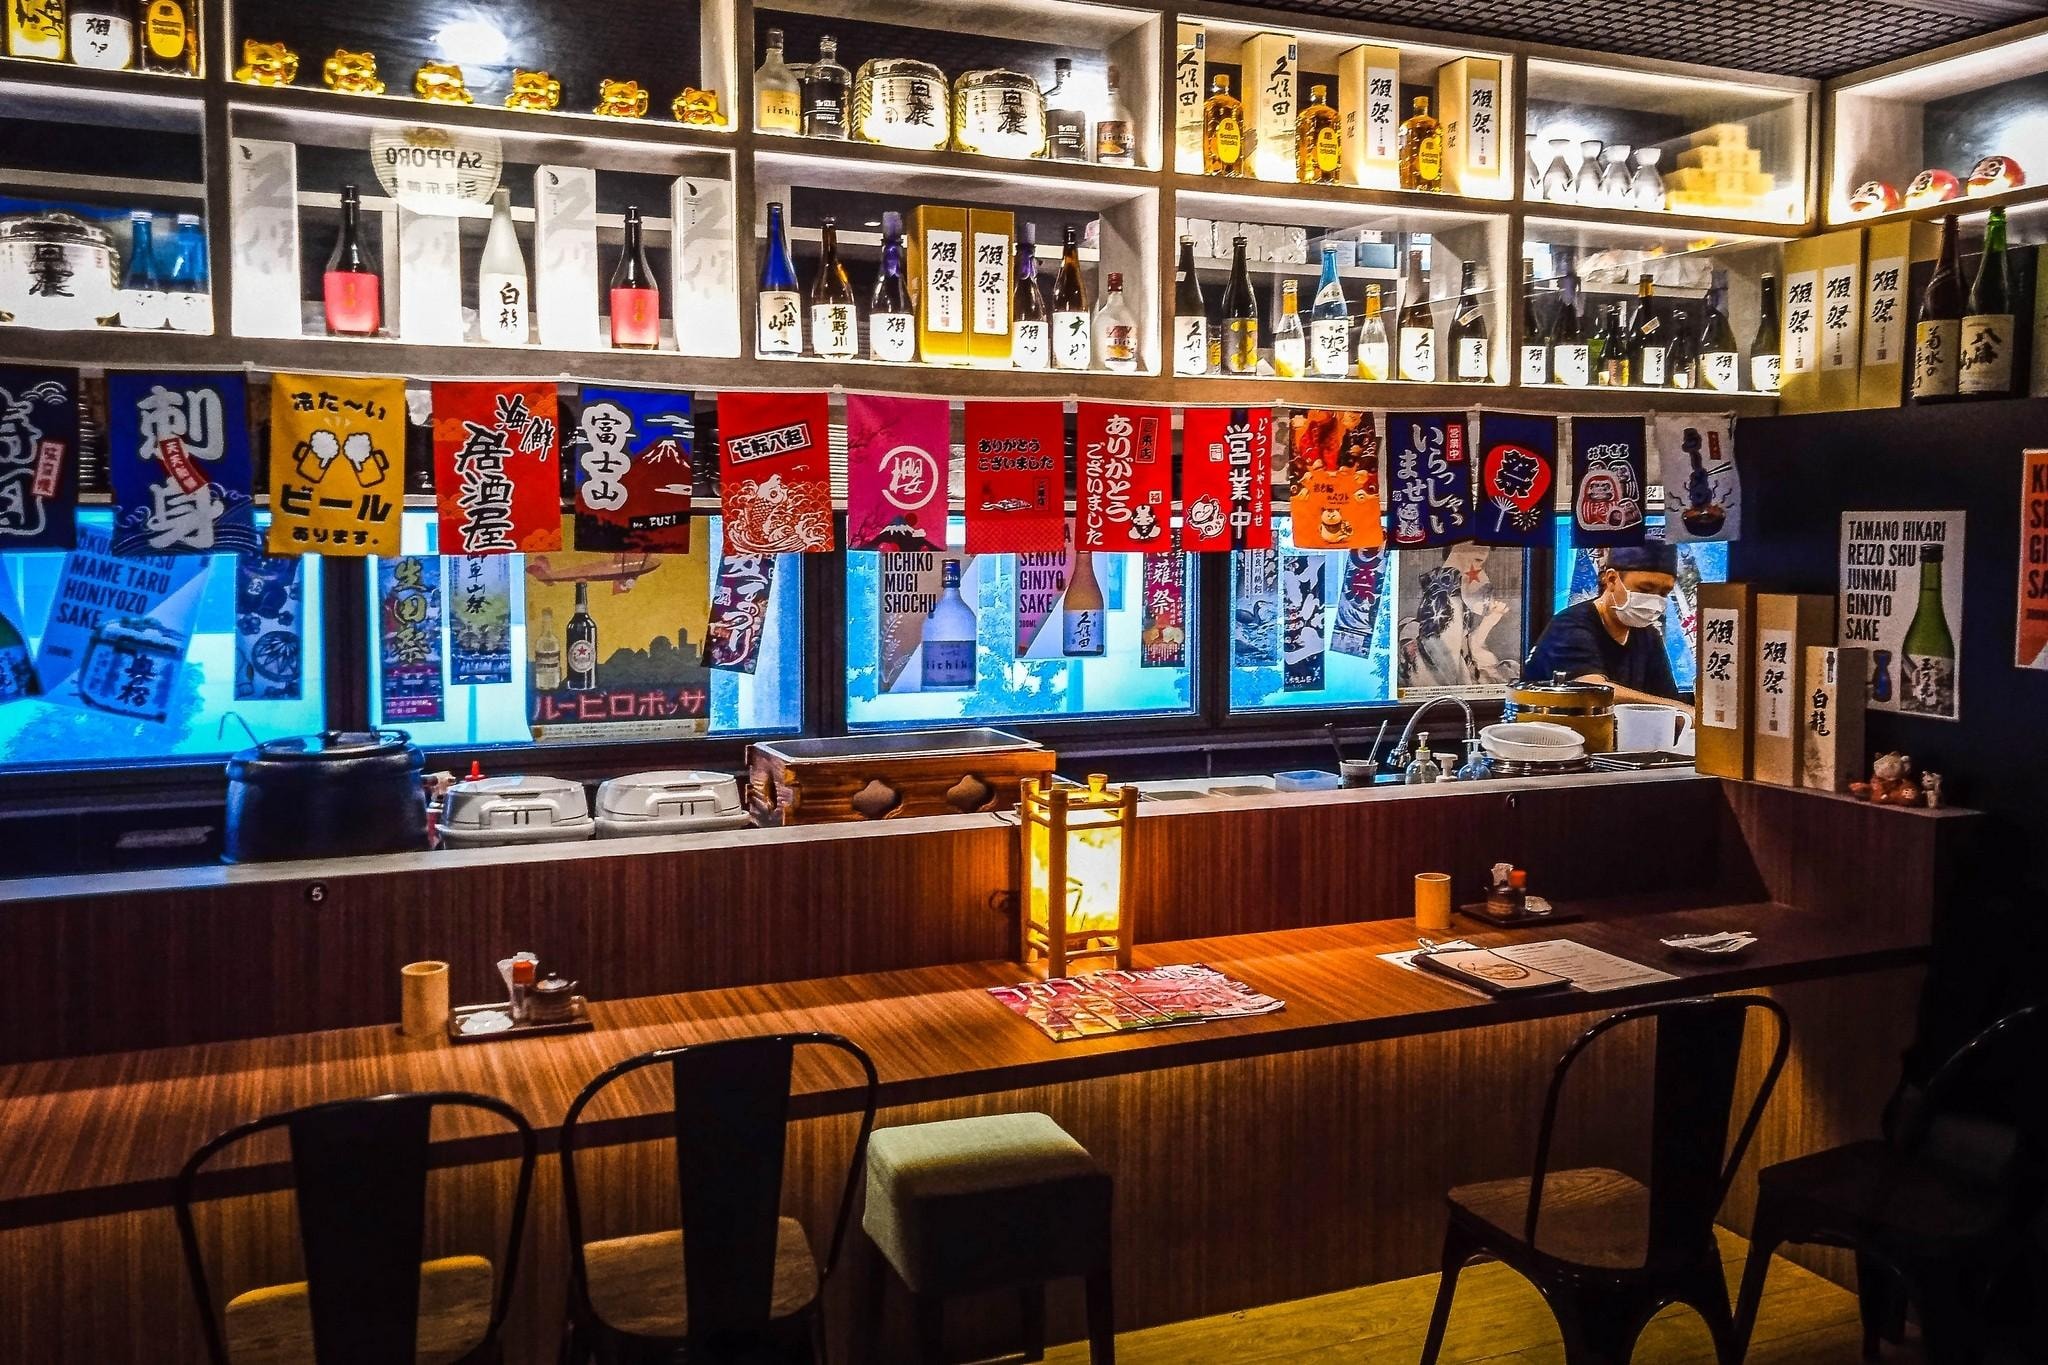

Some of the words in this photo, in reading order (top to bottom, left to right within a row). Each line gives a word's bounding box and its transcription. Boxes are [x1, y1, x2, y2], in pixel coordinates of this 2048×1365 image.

[1176, 47, 1200, 107] 久保田
[1265, 55, 1292, 116] 久保田
[1370, 78, 1393, 125] 獺祭
[1471, 89, 1493, 135] 獺祭
[931, 241, 958, 292] 獺祭
[978, 244, 1004, 294] 獺祭
[1788, 281, 1813, 334] 獺祭
[1826, 276, 1852, 330] 獺祭
[1872, 268, 1899, 324] 獺祭
[495, 394, 555, 461] 海鮮
[733, 425, 804, 458] 七転八起
[978, 438, 1041, 454] ありがとう
[137, 385, 224, 549] 刺身
[590, 412, 622, 502] 富士山
[977, 456, 1055, 472] ございました
[1104, 413, 1134, 523] ありがとう
[280, 483, 393, 522] ビール
[454, 420, 516, 551] 居酒屋
[1086, 441, 1105, 546] ございました
[1223, 423, 1254, 540] 営業中
[292, 526, 379, 546] あります。
[648, 514, 677, 527] FUJI
[1847, 520, 1899, 542] TAMANO
[1901, 520, 1947, 542] HIKARI
[70, 553, 124, 585] MAME
[126, 566, 171, 595] TARU
[1847, 543, 1885, 566] REIZO
[1888, 544, 1917, 567] SHU
[884, 574, 919, 593] MUGI
[1847, 568, 1897, 592] JUNMAI
[57, 601, 103, 631] SAKE
[884, 594, 937, 614] SHOCHU
[1020, 593, 1053, 614] SAKE
[1846, 592, 1892, 617] GINJYO
[1073, 610, 1091, 648] 久保田
[1706, 619, 1735, 682] 獺祭
[1845, 616, 1880, 642] SAKE
[1762, 641, 1788, 695] 獺祭
[1809, 688, 1831, 737] 白龍
